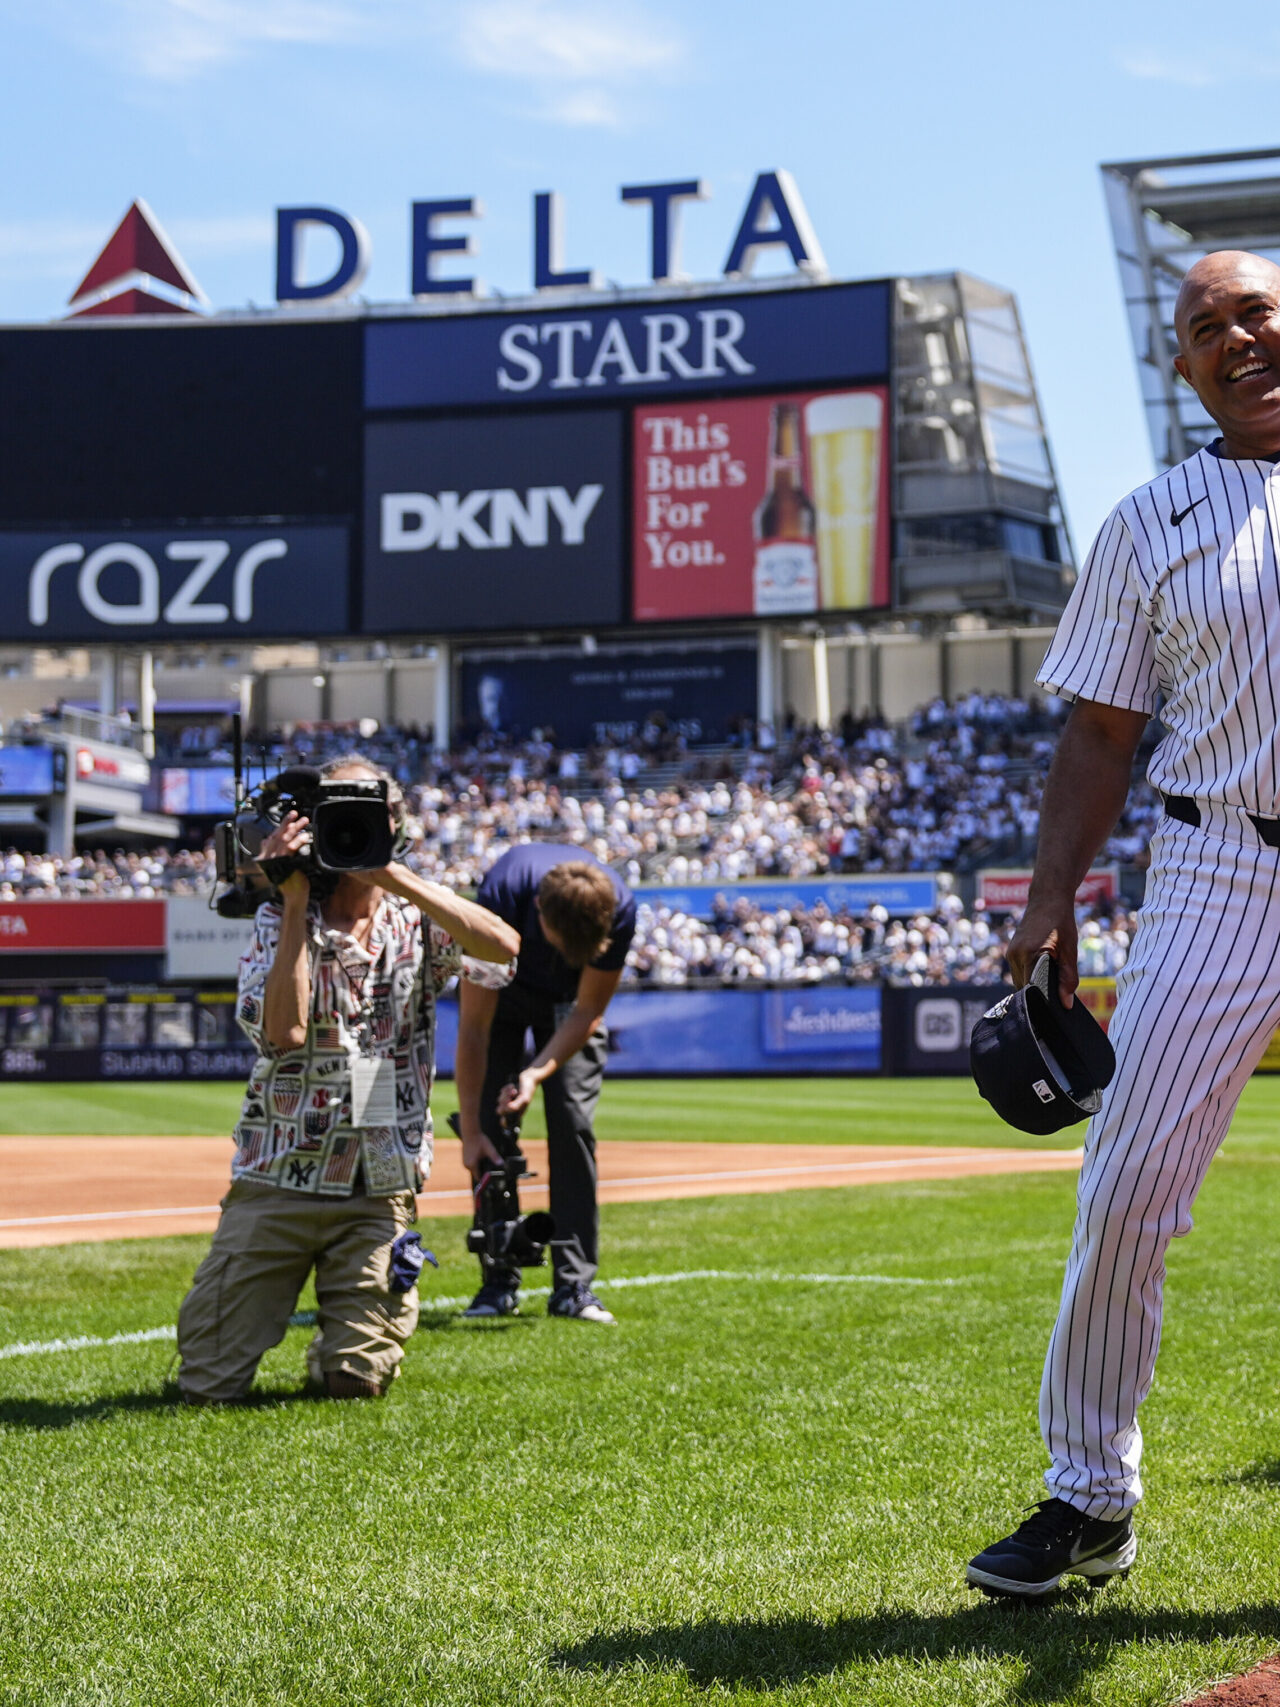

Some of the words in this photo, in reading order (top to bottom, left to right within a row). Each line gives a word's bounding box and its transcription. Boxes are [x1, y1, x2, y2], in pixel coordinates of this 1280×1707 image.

[275, 169, 826, 302] DELTA
[497, 308, 755, 391] STARR
[643, 414, 730, 454] This
[647, 452, 747, 491] Bud's
[380, 484, 604, 552] DKNY
[646, 494, 709, 530] For
[645, 532, 726, 569] You.
[29, 538, 289, 625] razr
